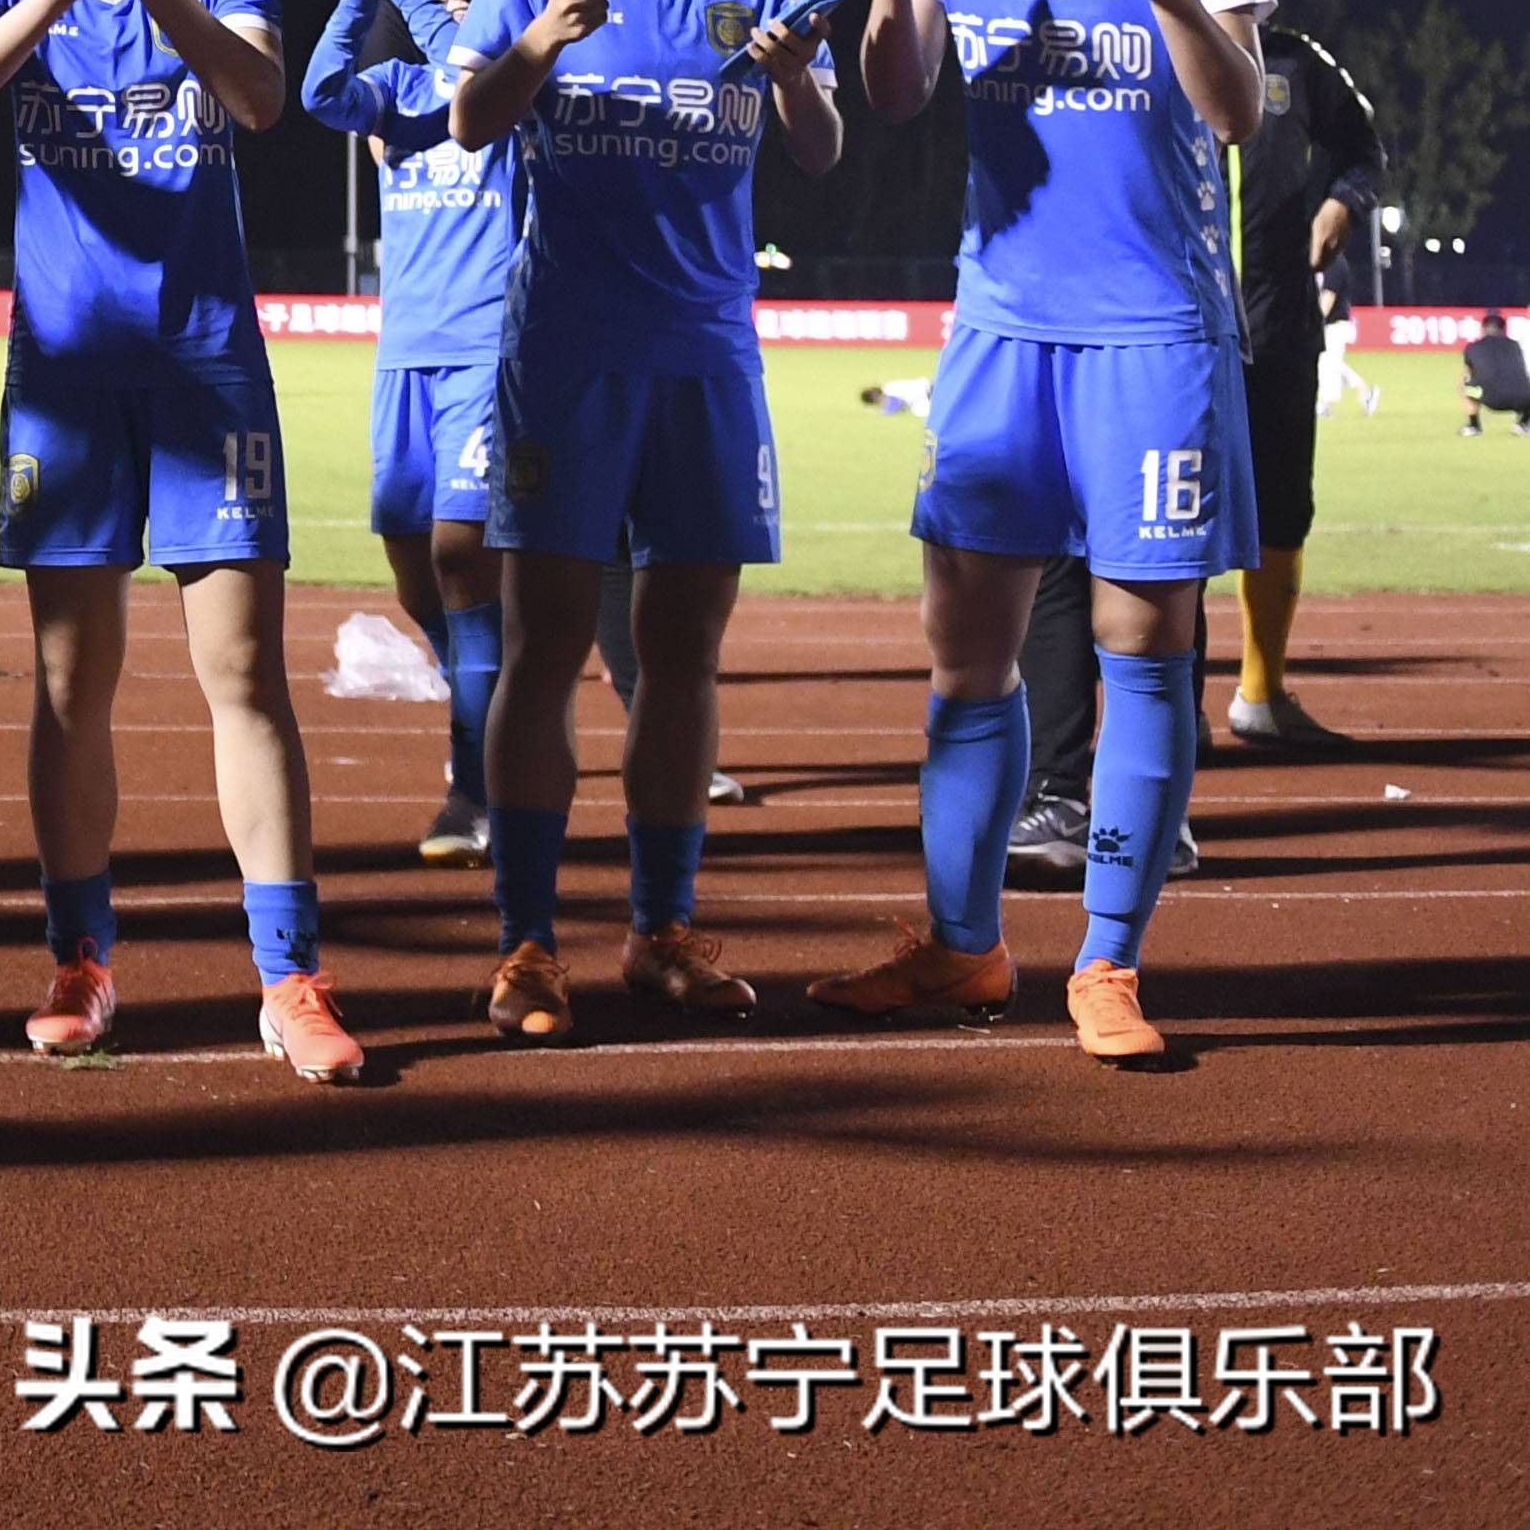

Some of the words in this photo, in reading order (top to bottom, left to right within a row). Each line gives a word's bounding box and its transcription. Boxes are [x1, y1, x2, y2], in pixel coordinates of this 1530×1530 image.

[946, 12, 1152, 81] 苏宁易购
[18, 79, 226, 140] 苏宁易购
[555, 73, 762, 138] 苏宁易购
[19, 143, 226, 178] suning.com
[555, 133, 752, 168] suning.com
[223, 431, 272, 501] 19
[459, 425, 491, 478] 4
[216, 506, 274, 520] KELME
[1140, 449, 1203, 522] 16
[1138, 525, 1208, 540] KELME
